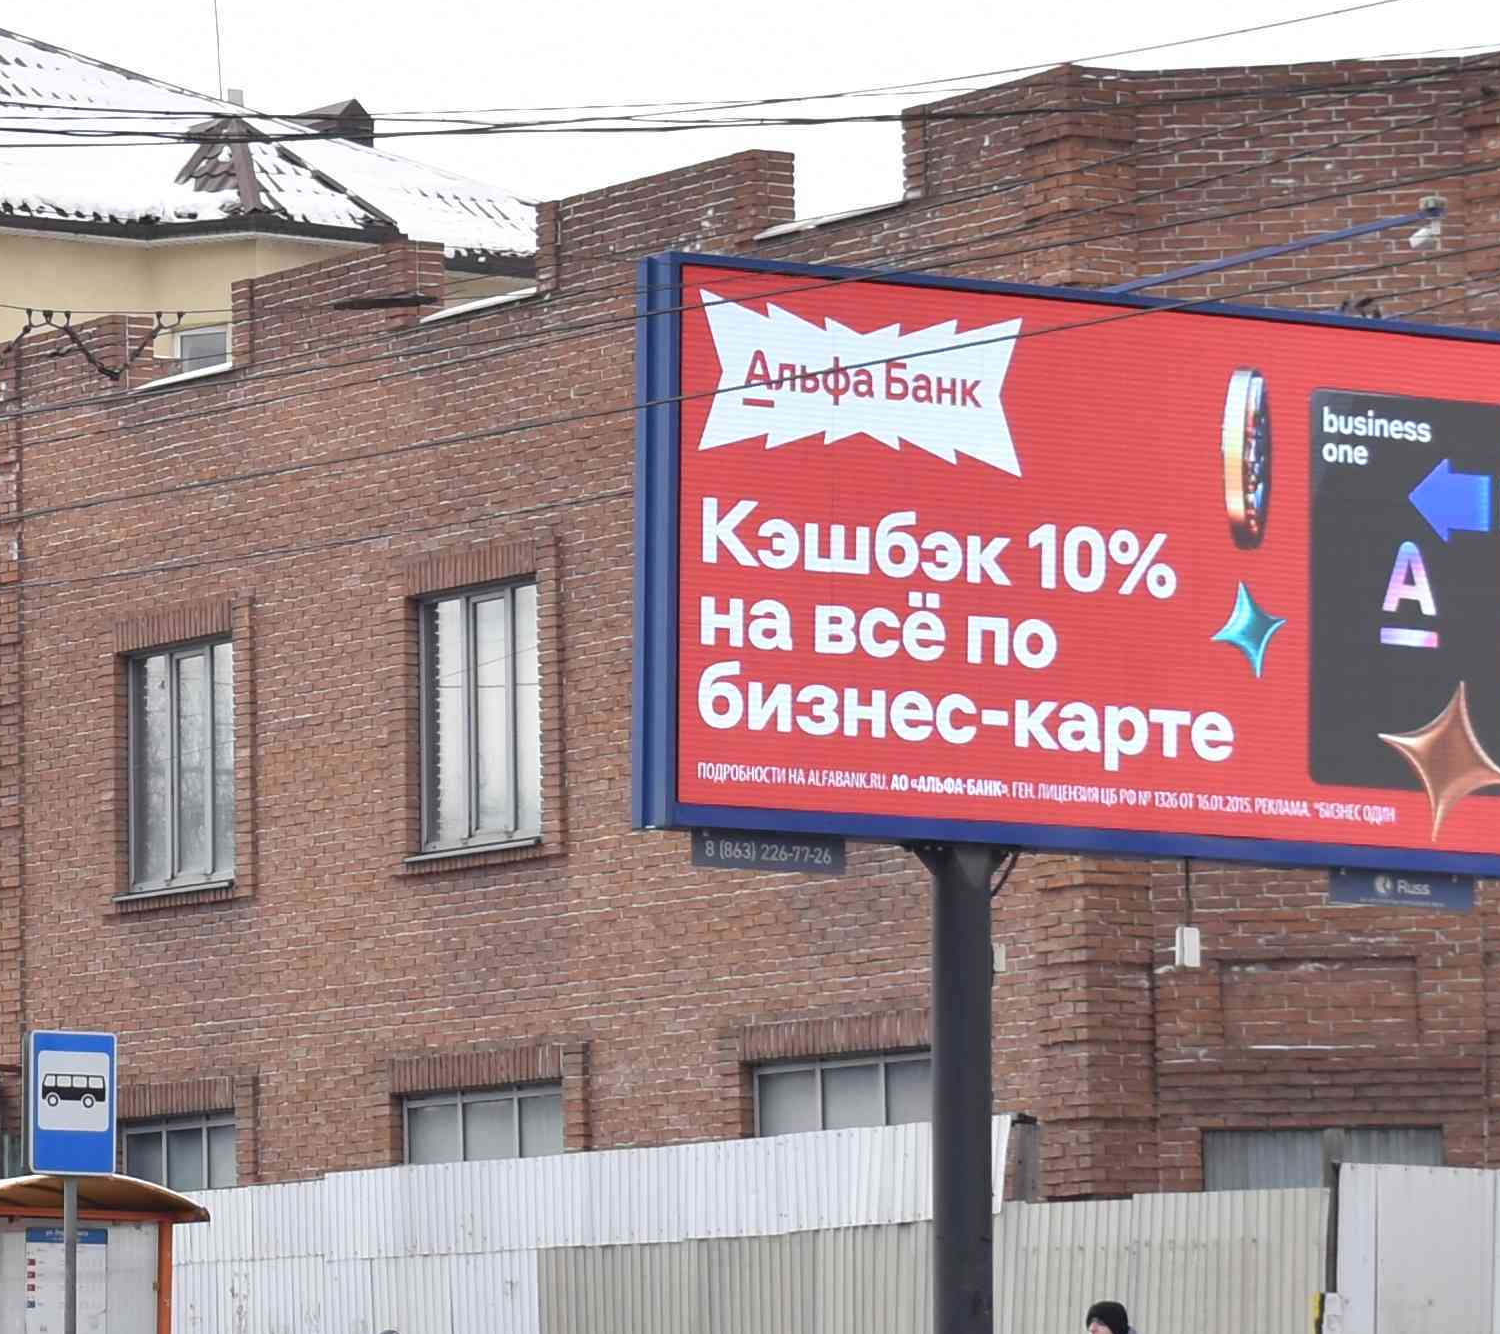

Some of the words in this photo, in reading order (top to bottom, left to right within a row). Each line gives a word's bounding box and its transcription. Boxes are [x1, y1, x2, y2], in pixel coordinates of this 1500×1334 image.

[743, 349, 875, 408] Альфа
[885, 361, 983, 408] Банк
[1322, 405, 1432, 443] business
[1321, 442, 1369, 465] one
[701, 496, 1012, 587] Кэшбэк
[1028, 523, 1178, 599] 10%
[700, 595, 793, 651] на
[814, 591, 946, 661] всё
[966, 614, 1058, 670] по
[697, 660, 1236, 772] бизнес-карте
[697, 761, 787, 784] ПОДРОБНОСТИ
[788, 769, 806, 785] НА
[890, 774, 909, 791] АО
[1012, 781, 1036, 799] ГЕН.
[1038, 783, 1100, 804] ЛИЦЕНЗИЯ
[1100, 787, 1118, 807] ЦБ
[1119, 788, 1137, 806] РФ
[1179, 793, 1194, 809] ОТ
[704, 840, 715, 858] 8
[719, 840, 757, 862] (863)
[760, 843, 833, 866] 226-77-26
[1397, 879, 1432, 896] Russ
